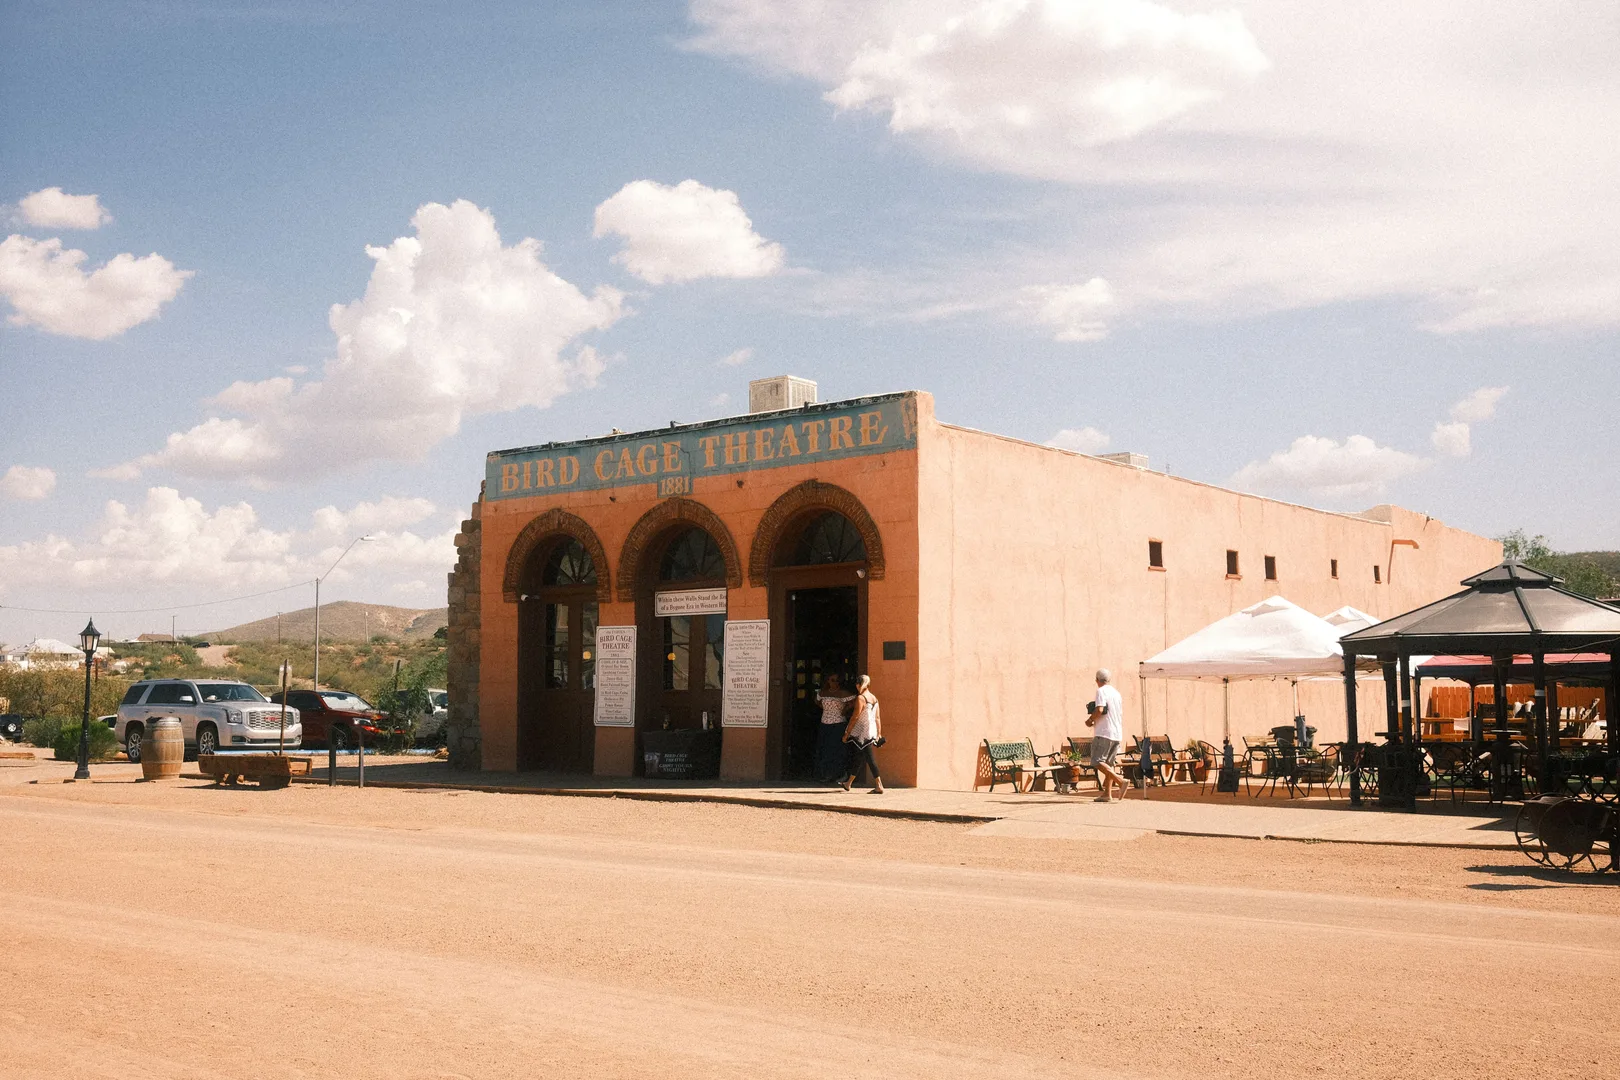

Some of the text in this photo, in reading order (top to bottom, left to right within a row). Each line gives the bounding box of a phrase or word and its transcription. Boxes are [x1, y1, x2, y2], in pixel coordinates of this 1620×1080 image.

[500, 410, 889, 493] BIRD CAGE THEATRE
[660, 476, 691, 497] 1881
